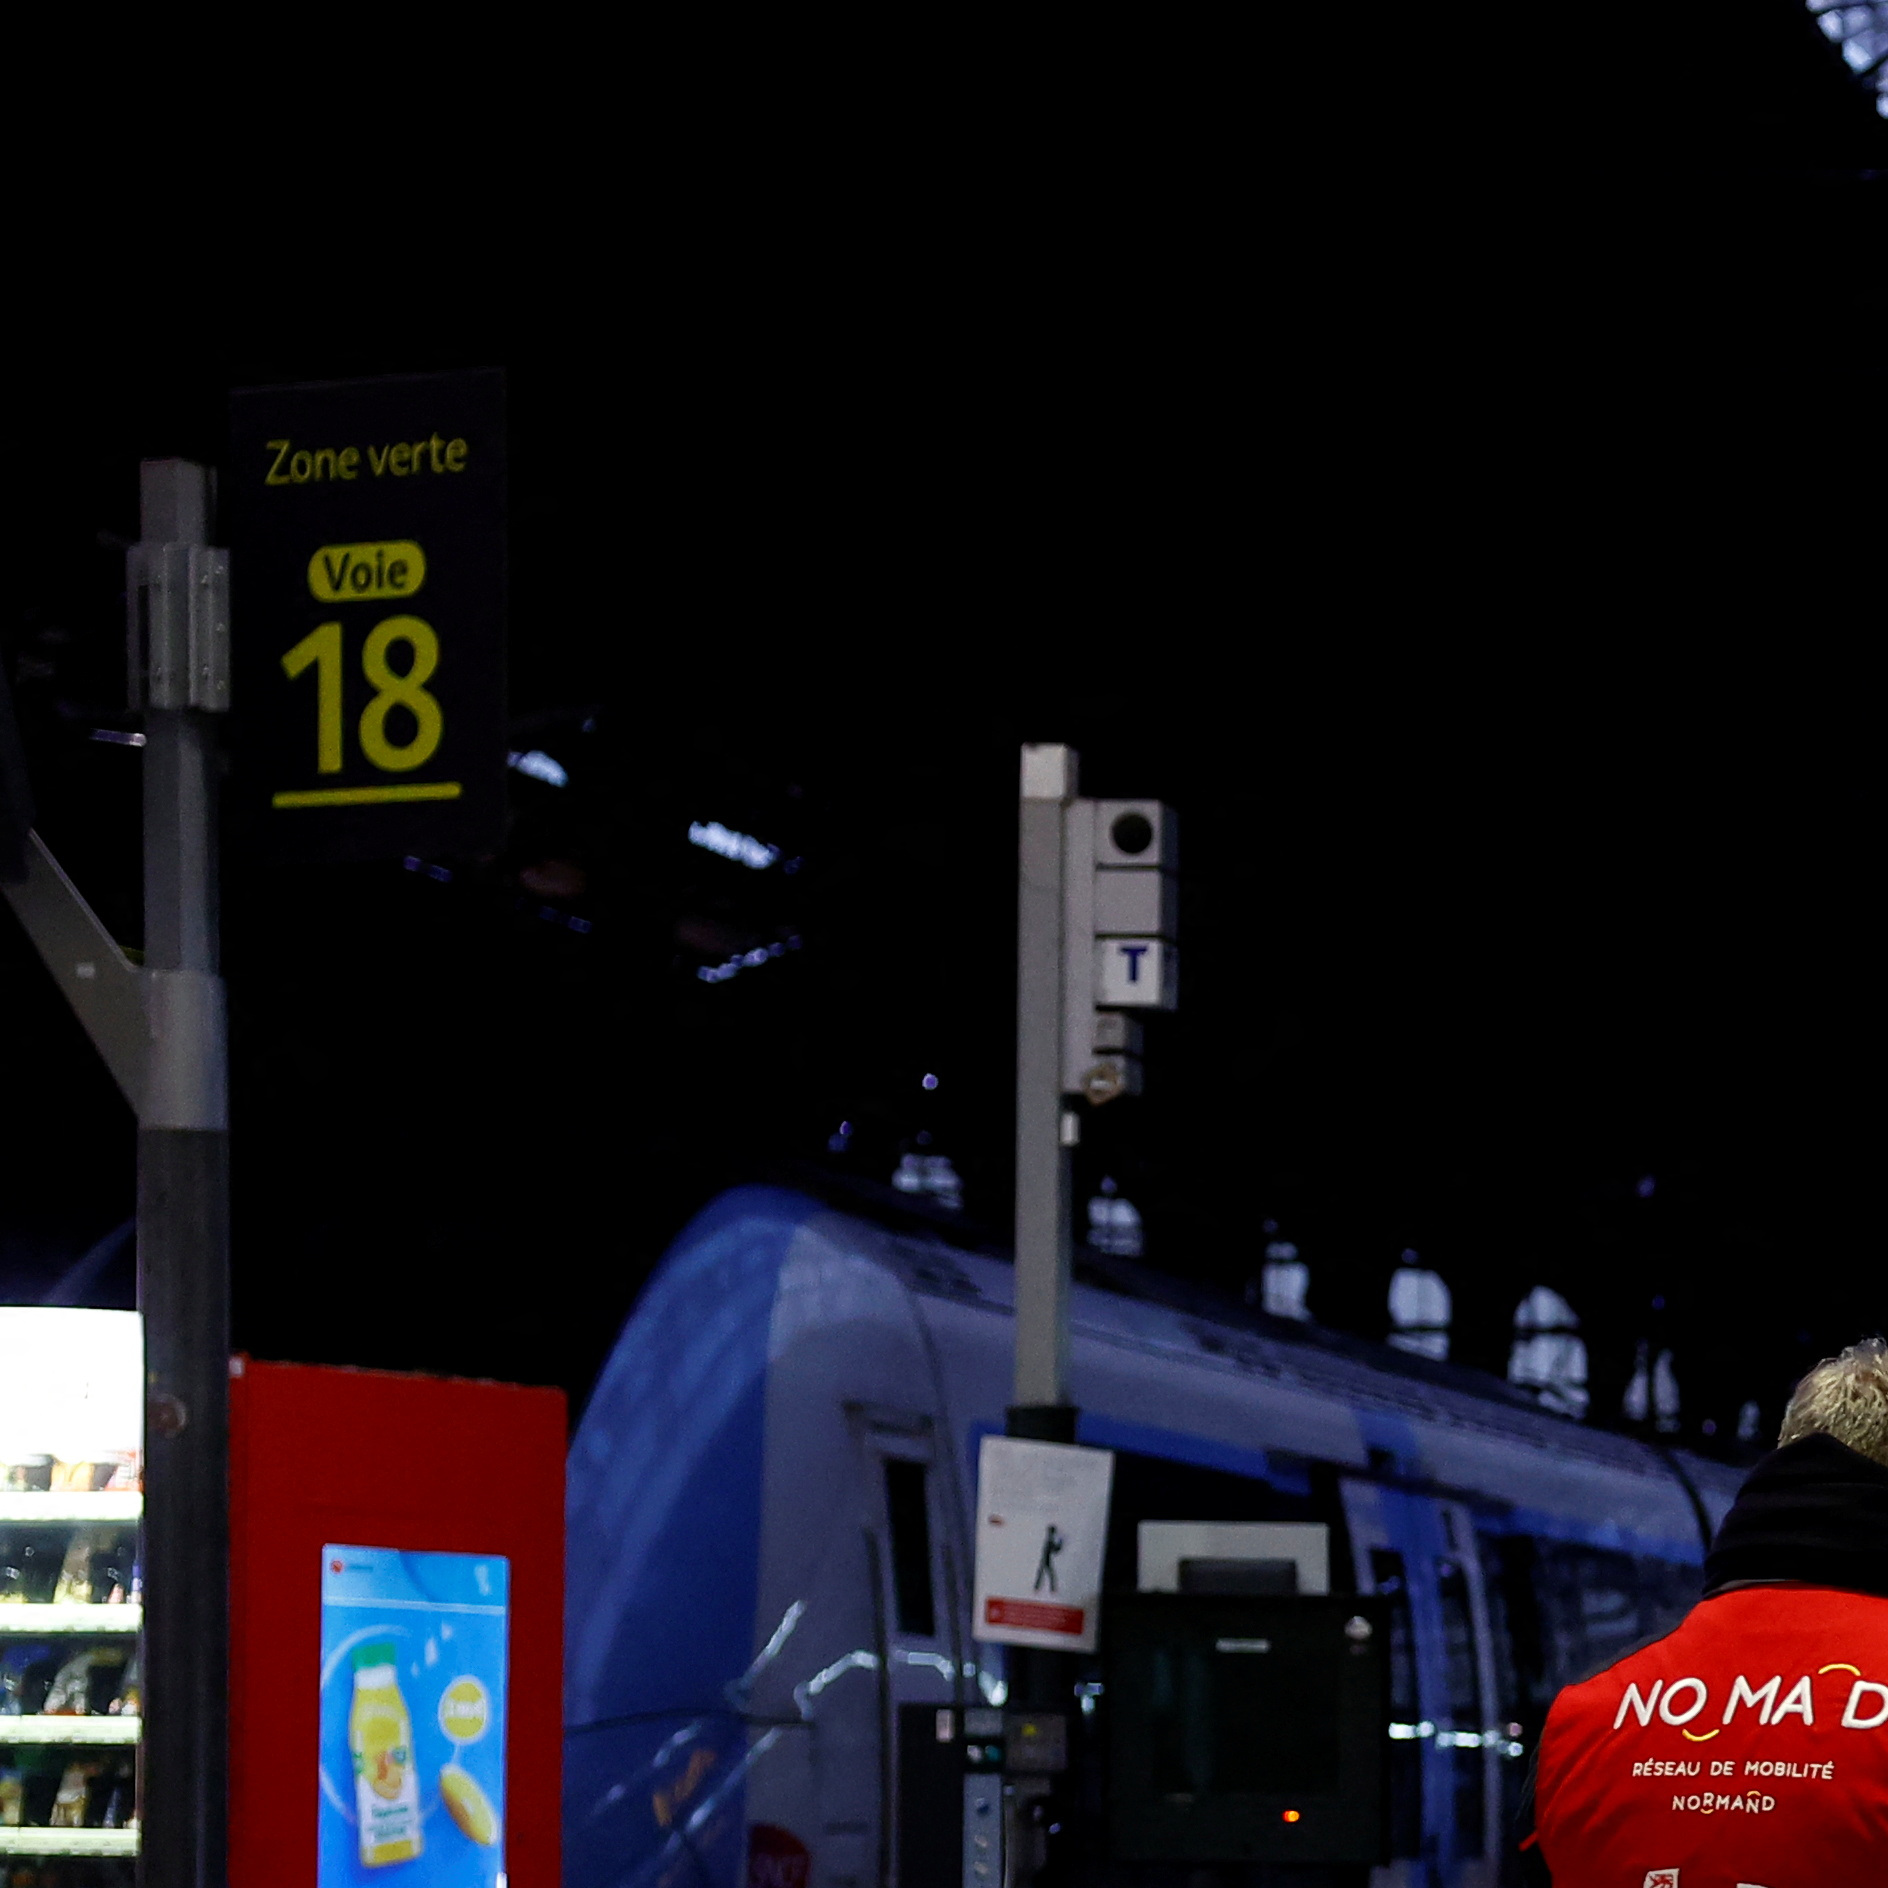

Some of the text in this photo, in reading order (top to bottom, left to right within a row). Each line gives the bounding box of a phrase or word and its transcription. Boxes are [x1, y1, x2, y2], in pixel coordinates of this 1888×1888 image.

[265, 432, 469, 485] Zone verte
[324, 550, 410, 593] Voie
[280, 613, 443, 774] 18
[1120, 945, 1149, 983] T
[1632, 1757, 1835, 1780] RÉSEAU DE MOBILITÉ
[1672, 1791, 1775, 1814] NORMAND
